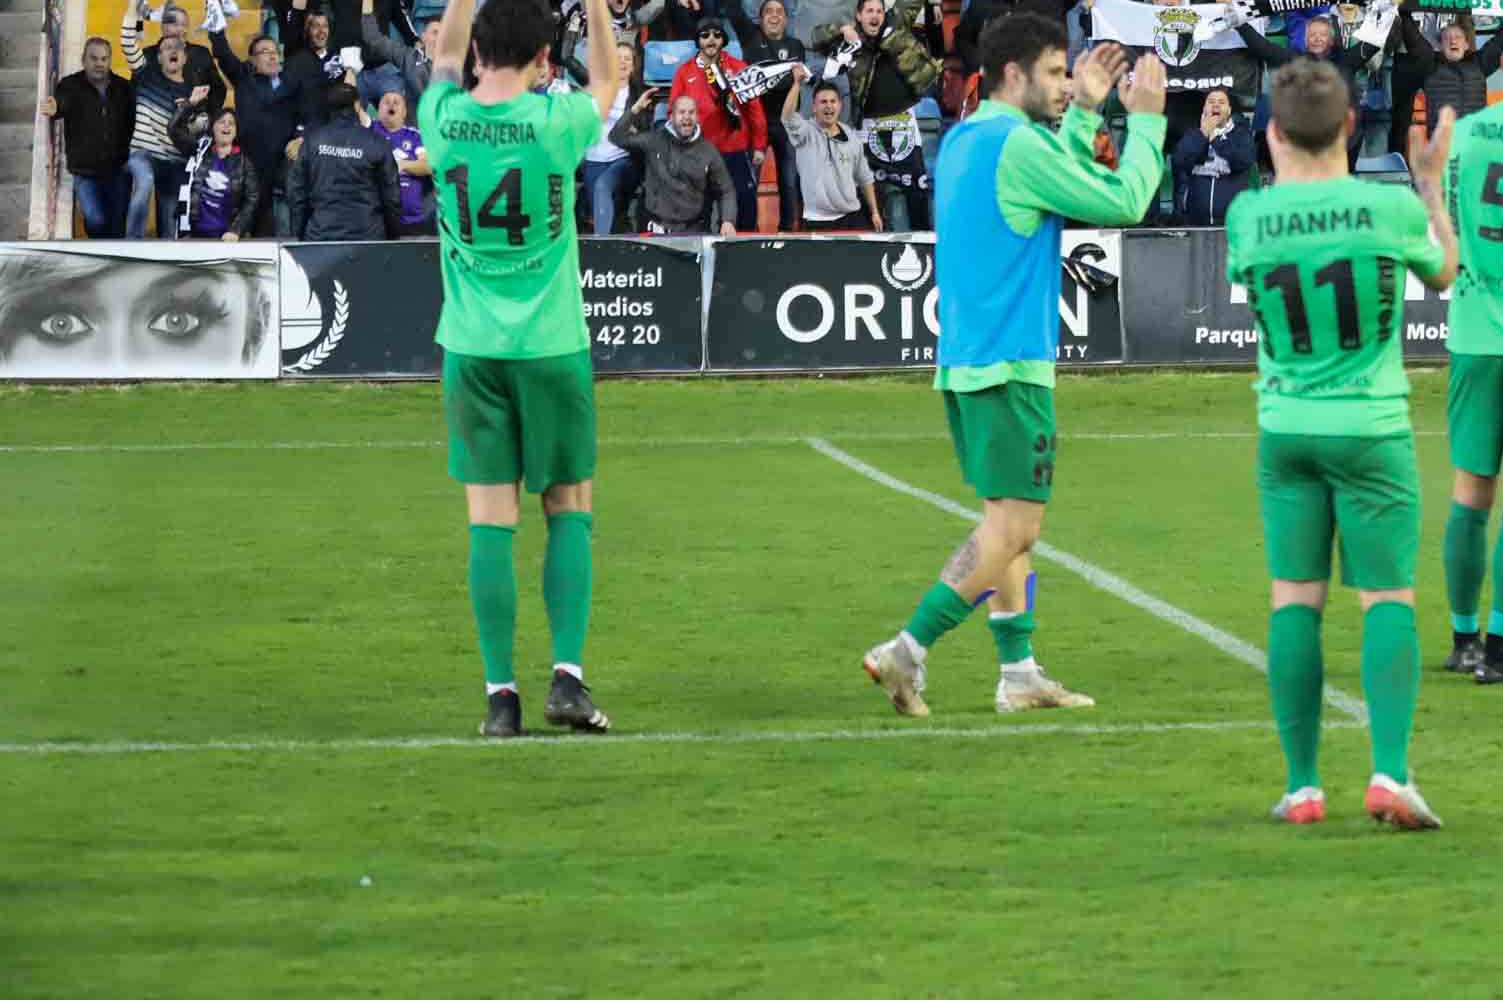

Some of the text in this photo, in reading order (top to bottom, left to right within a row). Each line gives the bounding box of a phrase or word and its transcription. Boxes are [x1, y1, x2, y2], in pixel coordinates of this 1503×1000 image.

[318, 143, 363, 159] SEGURIDAD
[443, 163, 532, 247] 14
[1256, 206, 1375, 244] JUANMA
[583, 298, 654, 317] endios
[1263, 257, 1363, 355] 11
[596, 325, 661, 345] 42 20
[1194, 326, 1262, 348] Parqu
[900, 347, 936, 361] FIR
